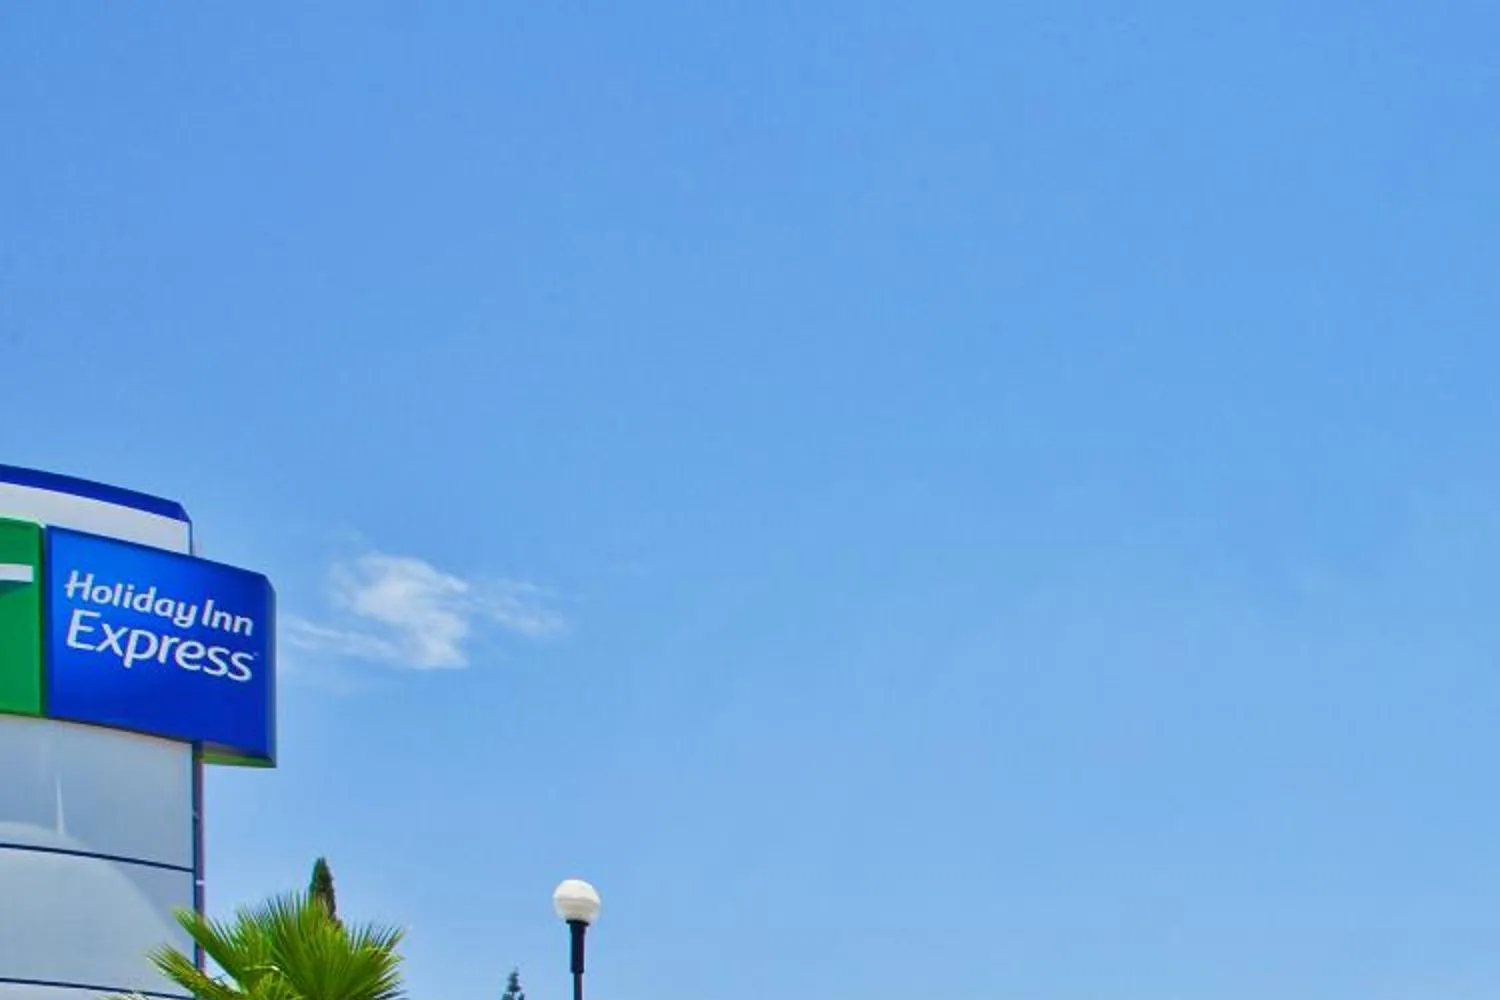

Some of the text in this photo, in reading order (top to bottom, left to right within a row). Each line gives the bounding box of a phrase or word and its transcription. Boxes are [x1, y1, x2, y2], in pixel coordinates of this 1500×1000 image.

[65, 570, 254, 636] Holiday Inn
[66, 608, 254, 682] Express
